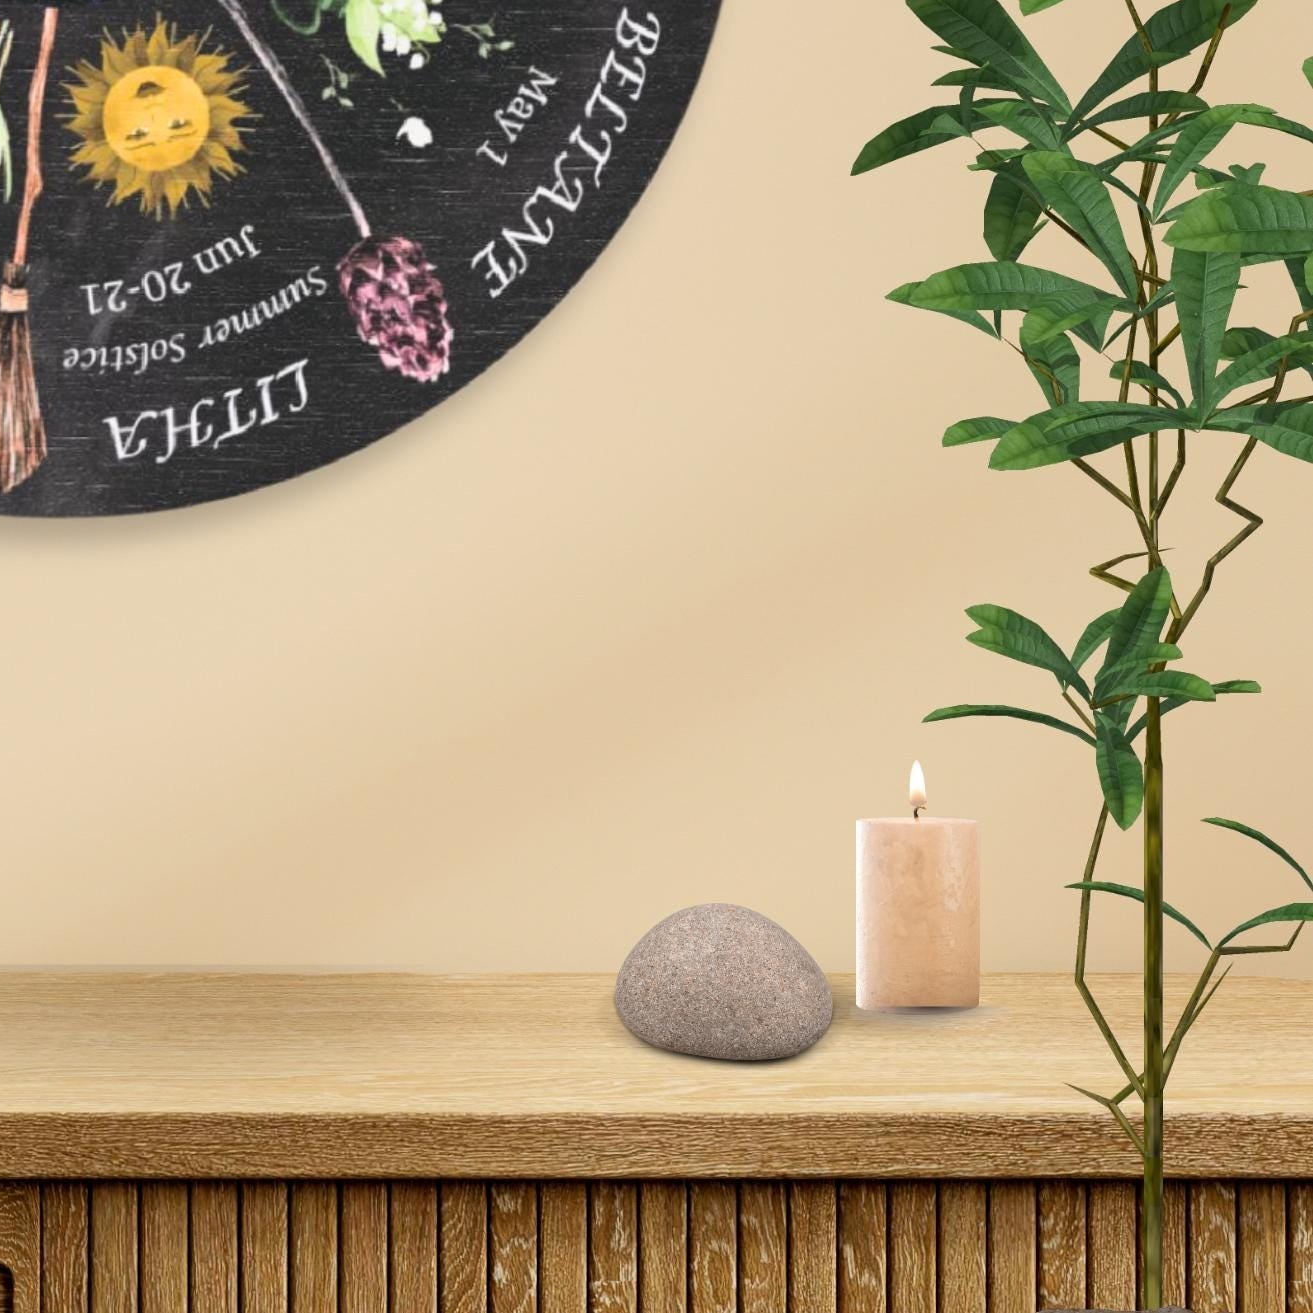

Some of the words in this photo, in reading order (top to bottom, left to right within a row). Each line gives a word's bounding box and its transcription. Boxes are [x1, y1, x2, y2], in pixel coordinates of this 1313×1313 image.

[494, 66, 558, 143] May
[471, 6, 660, 298] BELTANE
[476, 140, 508, 166] 1
[193, 224, 261, 274] Jun
[80, 262, 191, 315] 20-21
[198, 266, 327, 349] Summer
[63, 333, 186, 375] Solstice
[103, 358, 309, 464] LITHA
